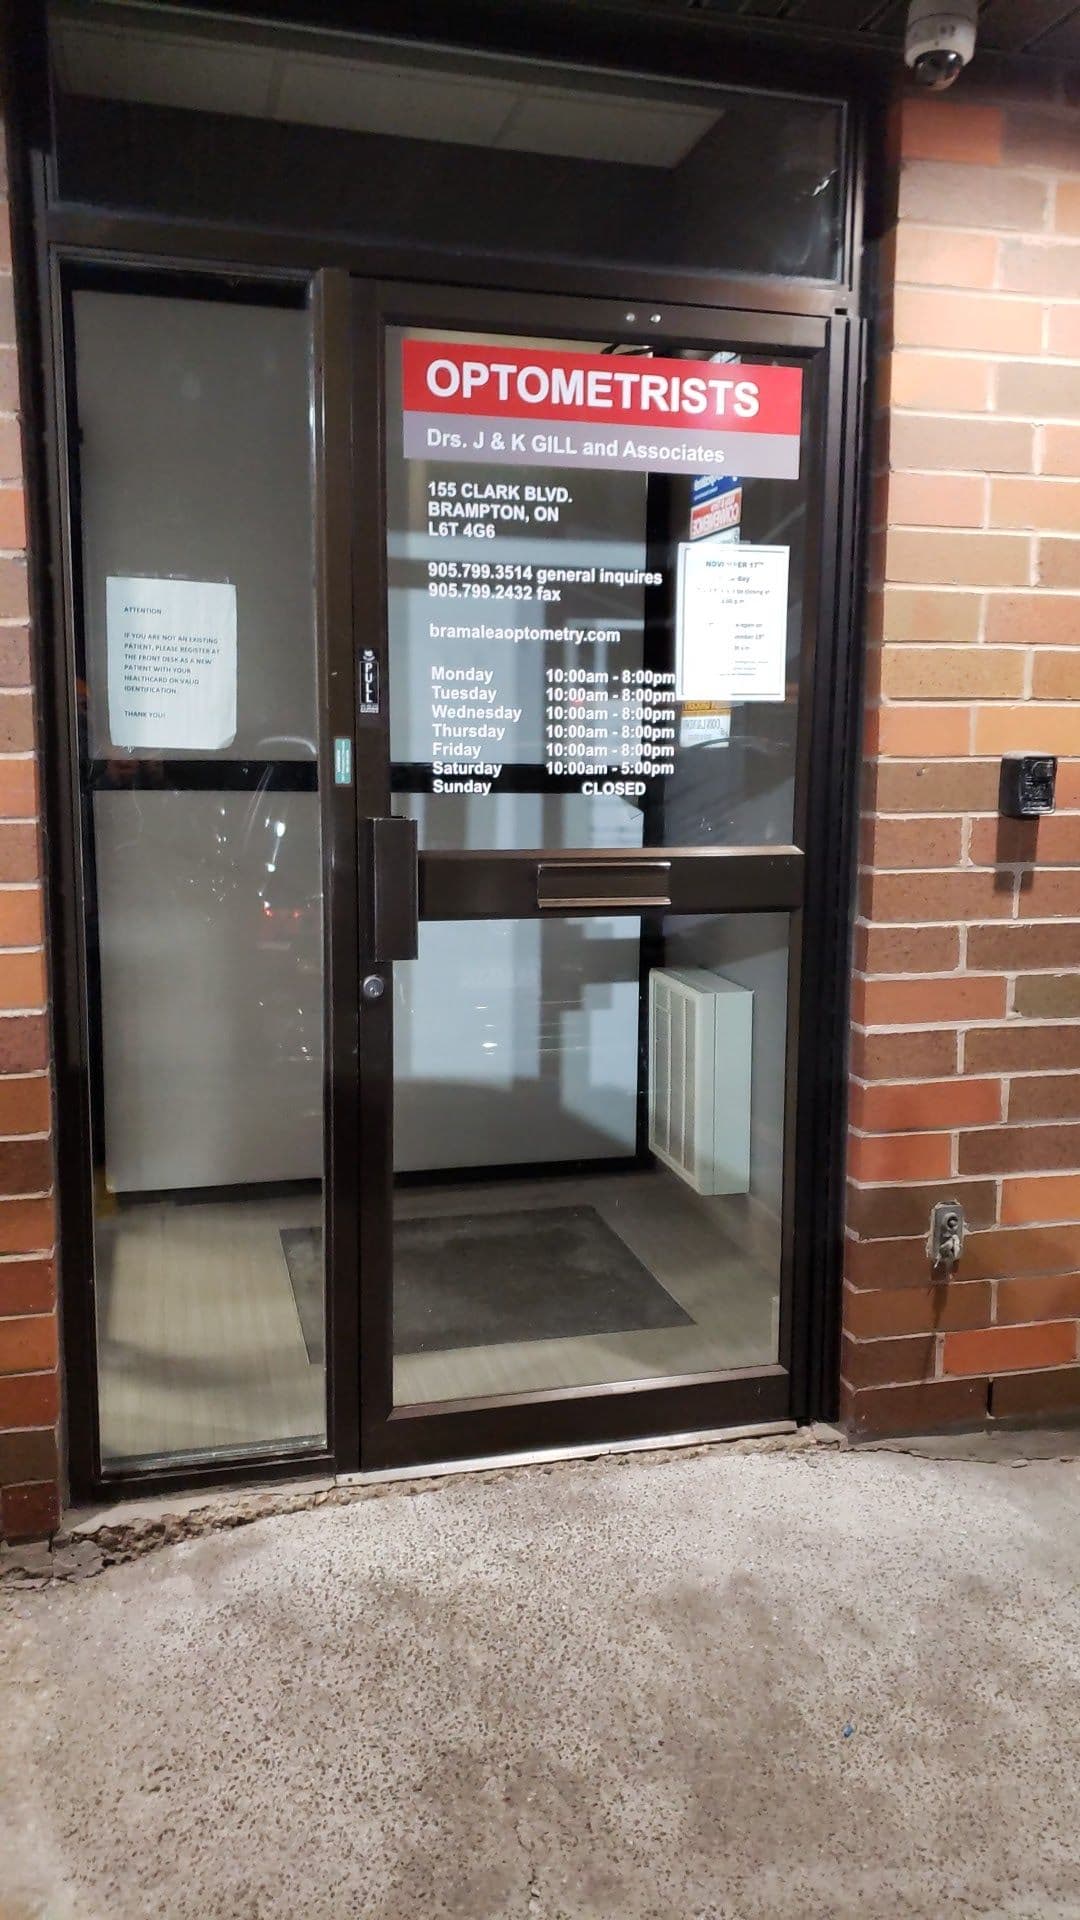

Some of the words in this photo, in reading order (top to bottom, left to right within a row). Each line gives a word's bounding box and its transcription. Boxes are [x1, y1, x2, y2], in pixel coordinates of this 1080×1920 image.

[426, 359, 760, 418] OPTOMETRISTS
[427, 428, 467, 448] Drs.
[473, 432, 485, 450] J
[491, 433, 505, 451] &
[511, 434, 526, 452] K
[532, 435, 577, 455] GILL
[583, 439, 618, 457] and
[623, 441, 725, 463] Associates
[428, 482, 457, 498] 155
[461, 483, 520, 501] CLARK
[525, 486, 573, 503] BLVD.
[428, 501, 529, 522] BRAMPTON,
[534, 506, 559, 522] ON
[428, 522, 459, 538] L6T
[463, 523, 496, 539] 4G6
[428, 562, 533, 581] 905.799.3514
[537, 567, 595, 586] general
[600, 568, 662, 586] inquires
[428, 582, 533, 601] 905.799.2432
[536, 586, 561, 602] fax
[124, 606, 162, 615] ATTENTION
[188, 636, 218, 645] EXISTING
[429, 623, 620, 643] bramaleaoptometry.com
[124, 653, 137, 661] THE
[138, 654, 161, 662] FRONT
[196, 657, 212, 665] NEW
[180, 646, 210, 654] REGISTER
[211, 647, 220, 655] AT
[124, 664, 152, 672] PATIENT
[431, 666, 494, 685] Monday
[545, 669, 608, 683] 10:00am
[622, 669, 675, 686] 8:00pm
[124, 674, 168, 683] HEALTHCARD
[179, 677, 199, 685] VALID
[365, 662, 373, 703] PULL
[432, 685, 497, 703] Tuesday
[545, 687, 608, 702] 10:00am
[622, 687, 675, 704] 8:00pm
[124, 709, 147, 718] THANK
[432, 704, 522, 723] Wednesday
[545, 706, 608, 720] 10:00am
[622, 706, 675, 724] 8:00pm
[432, 723, 505, 741] Thursday
[545, 725, 608, 739] 10:00am
[622, 725, 675, 742] 8:00pm
[432, 742, 481, 760] Friday
[545, 743, 608, 757] 10:00am
[622, 743, 675, 760] 8:00pm
[432, 761, 502, 778] Saturday
[545, 762, 608, 776] 10:00am
[622, 762, 675, 778] 5:00pm
[432, 779, 492, 796] Sunday
[582, 781, 646, 796] CLOSED
